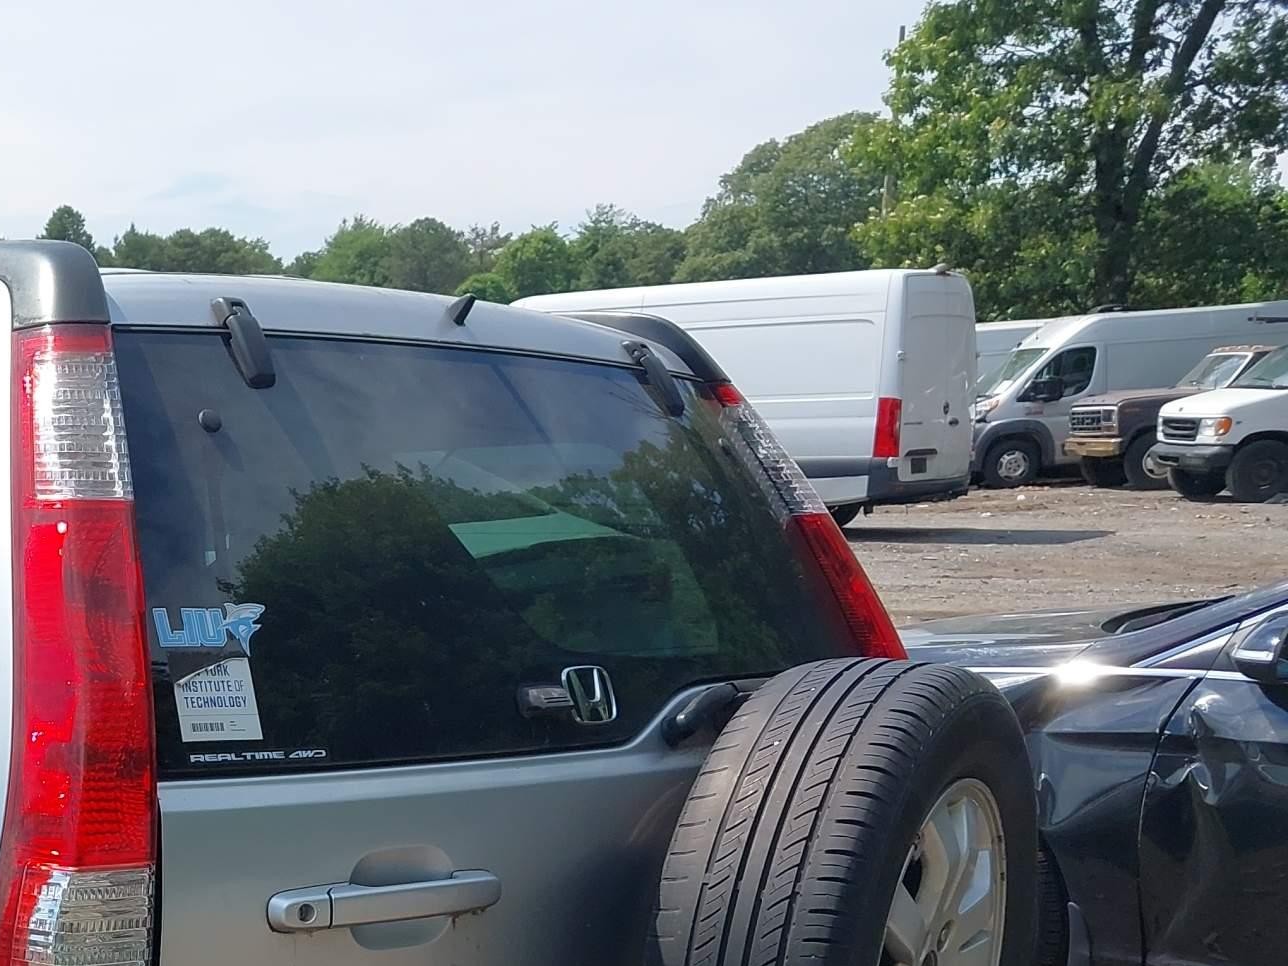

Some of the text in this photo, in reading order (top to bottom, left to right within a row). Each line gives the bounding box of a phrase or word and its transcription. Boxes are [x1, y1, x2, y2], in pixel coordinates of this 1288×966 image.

[152, 607, 227, 648] LIU
[182, 679, 244, 693] INSTITUTE OF
[184, 696, 247, 709] TECHNOLOGY
[289, 749, 327, 759] 4WD
